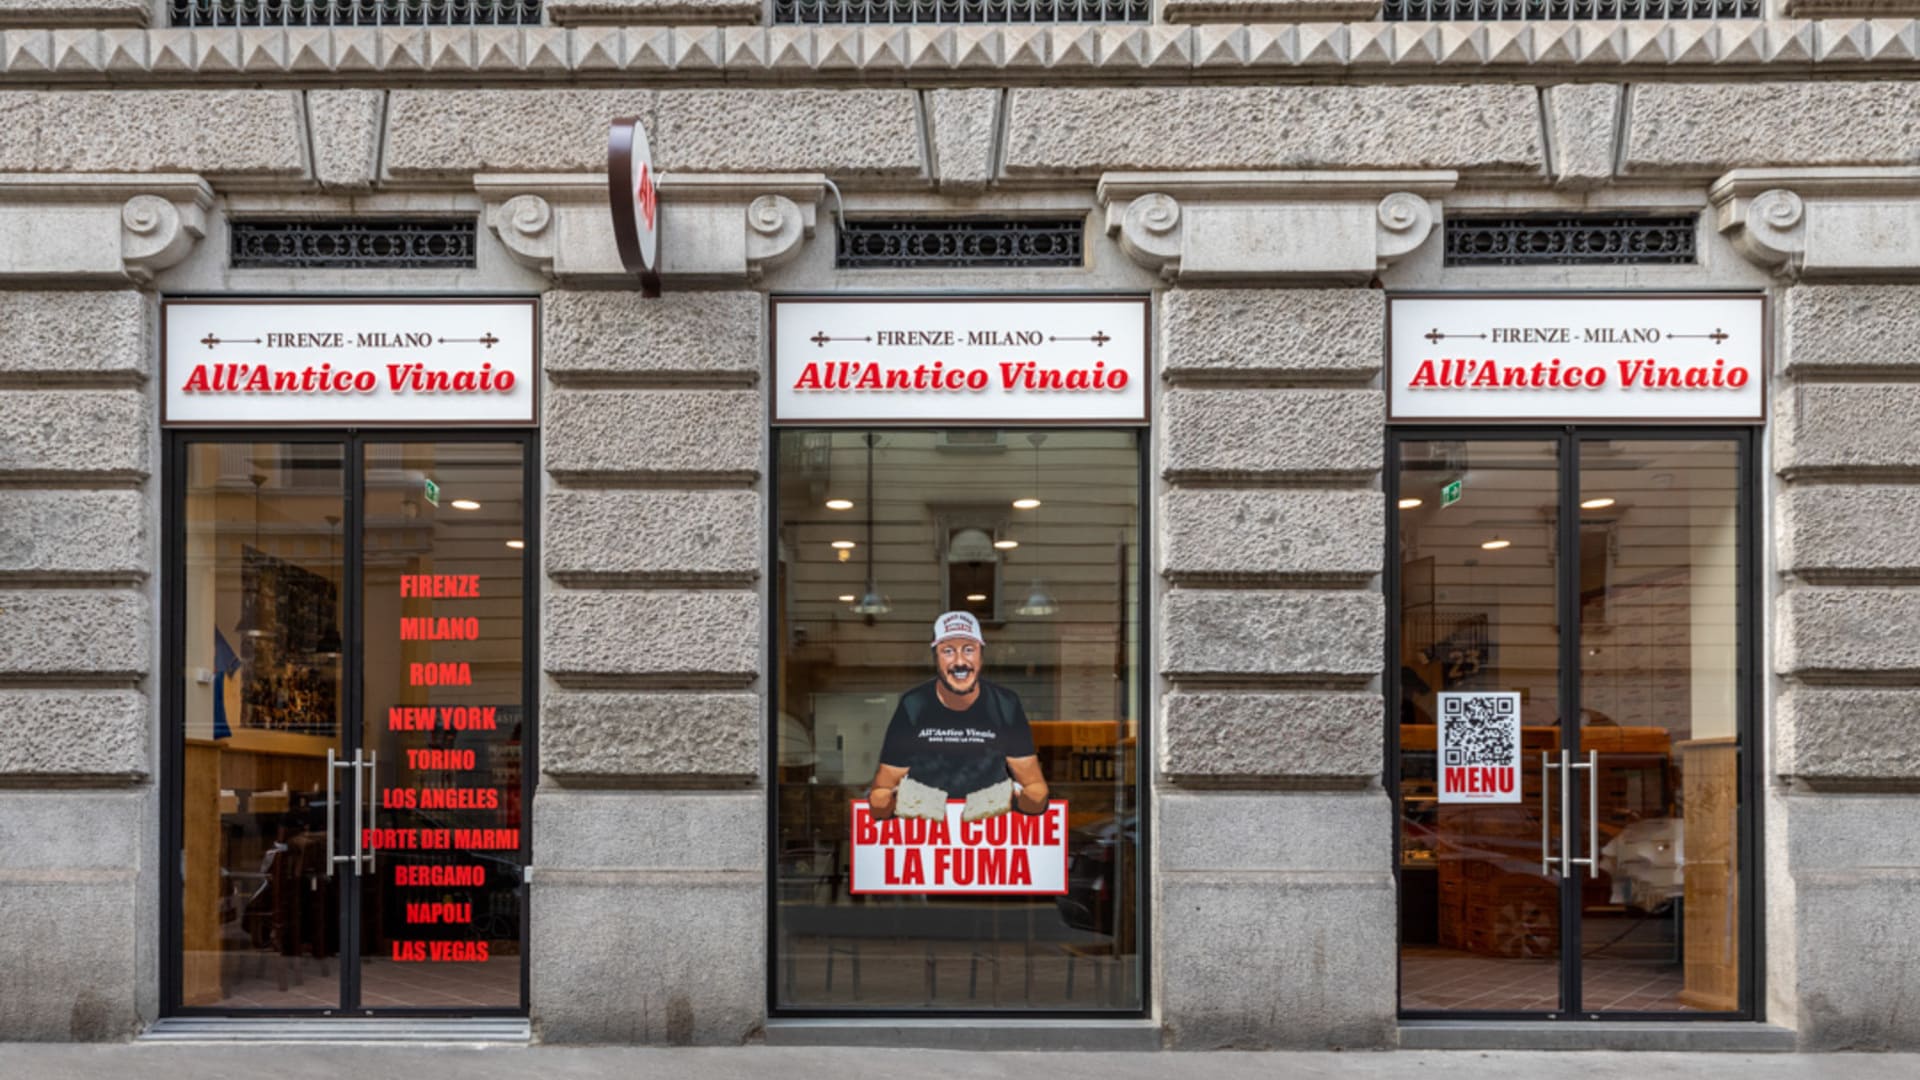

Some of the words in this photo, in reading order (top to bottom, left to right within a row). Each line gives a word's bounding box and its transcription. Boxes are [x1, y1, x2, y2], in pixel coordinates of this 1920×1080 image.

[267, 333, 344, 348] FIRENZE
[357, 333, 433, 348] MILANO
[877, 331, 955, 346] FIRENZE
[968, 331, 1043, 346] MILANO
[1491, 328, 1570, 343] FIRENZE
[1584, 328, 1660, 343] MILANO
[183, 363, 376, 392] All'Antico
[387, 362, 516, 392] Vinaio
[794, 361, 989, 390] All'Antico
[999, 361, 1129, 390] Vinaio
[1409, 358, 1606, 388] All'Antico
[1617, 358, 1749, 388] Vinaio
[400, 574, 480, 598] FIRENZE
[400, 617, 479, 640] MILANO
[410, 662, 472, 686] ROMA
[389, 708, 436, 731] NEW
[441, 707, 497, 731] YORK
[407, 749, 475, 771] TORINO
[1445, 767, 1515, 793] MENU
[384, 788, 416, 809] LOS
[420, 788, 498, 809] ANGELES
[362, 829, 416, 849] FORTE
[421, 829, 451, 849] DEI
[454, 829, 520, 850] MARMI
[395, 866, 486, 887] BERGAMO
[885, 848, 925, 885] LA
[934, 848, 1032, 885] FUMA
[407, 903, 471, 924] NAPOLI
[392, 941, 427, 962] LAS
[430, 941, 489, 962] VEGAS
